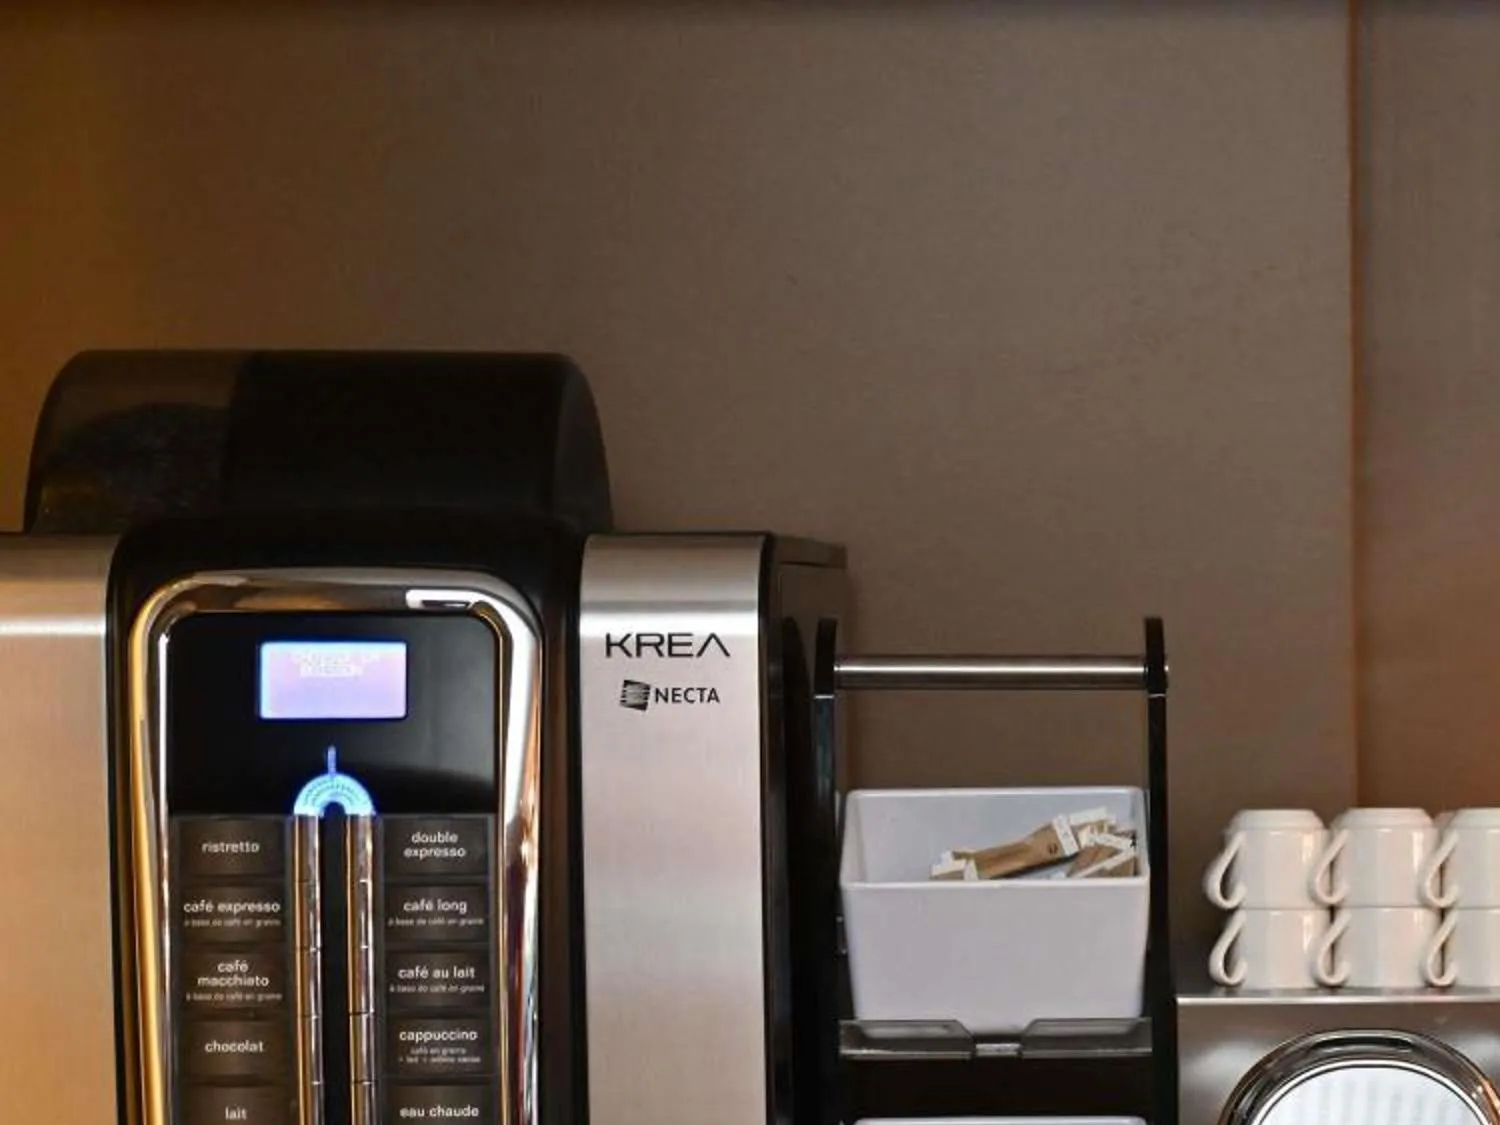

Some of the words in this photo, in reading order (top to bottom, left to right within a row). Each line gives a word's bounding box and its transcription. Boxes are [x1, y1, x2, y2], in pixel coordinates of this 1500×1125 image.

[605, 632, 731, 659] KREA
[654, 686, 721, 704] NECTA
[411, 831, 459, 844] double
[201, 841, 260, 854] ristretto
[403, 846, 467, 861] expresso
[183, 899, 215, 913] café
[217, 901, 281, 916] expresso
[403, 899, 434, 913] café
[436, 899, 468, 914] long
[217, 960, 249, 973] café
[398, 965, 429, 979] café
[433, 969, 450, 979] au
[453, 965, 476, 979] lait
[197, 974, 270, 987] macchiato
[399, 1030, 478, 1044] cappuccino
[204, 1040, 264, 1053] chocolat
[225, 1107, 248, 1120] lait
[400, 1108, 426, 1118] eau
[429, 1105, 480, 1118] chaude
